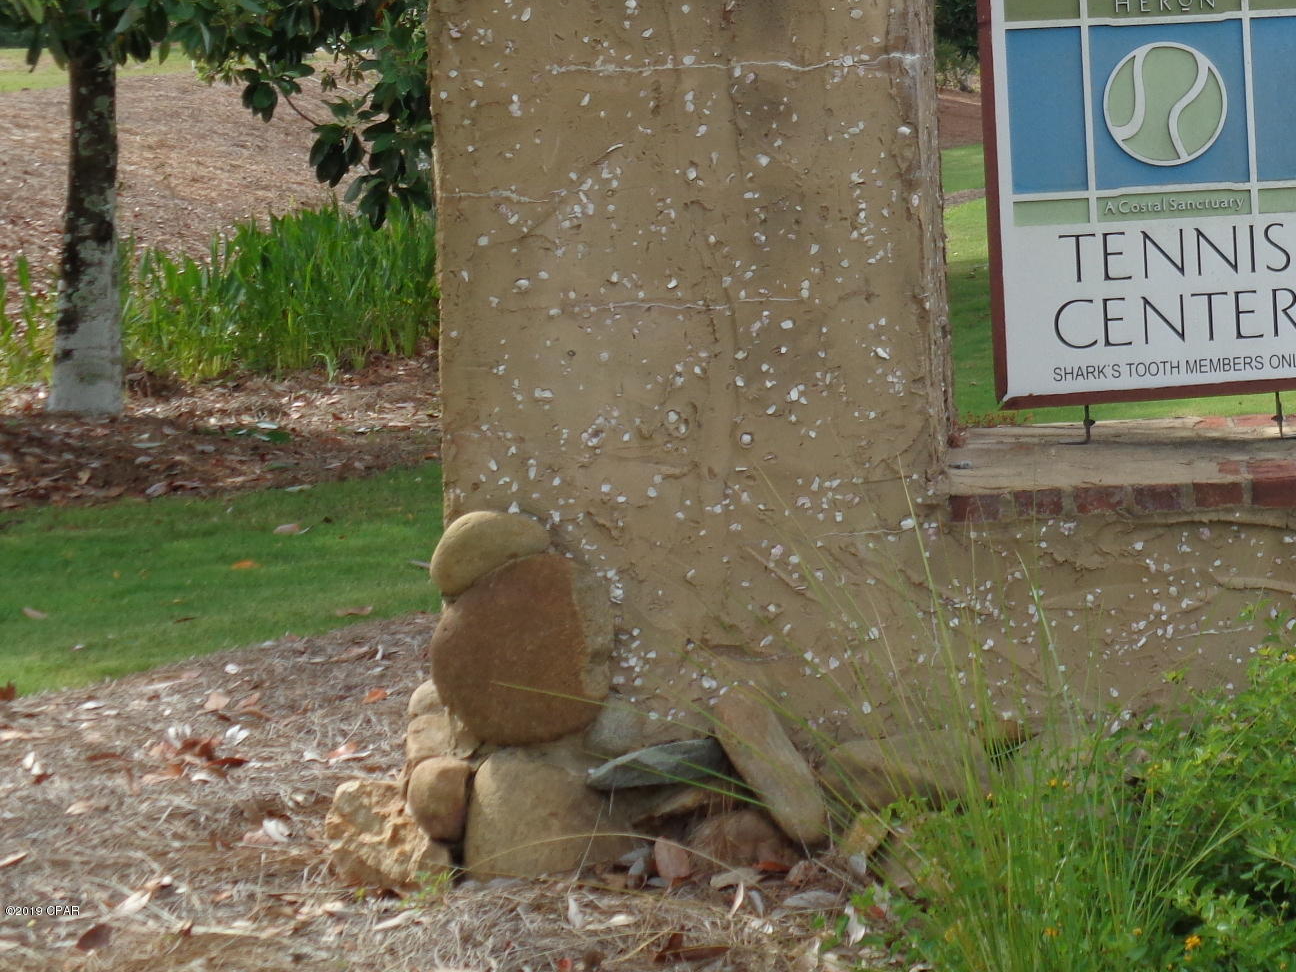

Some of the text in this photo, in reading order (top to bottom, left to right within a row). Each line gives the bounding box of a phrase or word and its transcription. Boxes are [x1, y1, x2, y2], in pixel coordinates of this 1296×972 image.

[1104, 196, 1244, 214] A Costal Sanctuary
[1058, 223, 1291, 282] TENNIS
[1053, 363, 1121, 382] SHARK'S
[1125, 360, 1180, 377] TOOTH
[1185, 355, 1264, 375] MEMBERS
